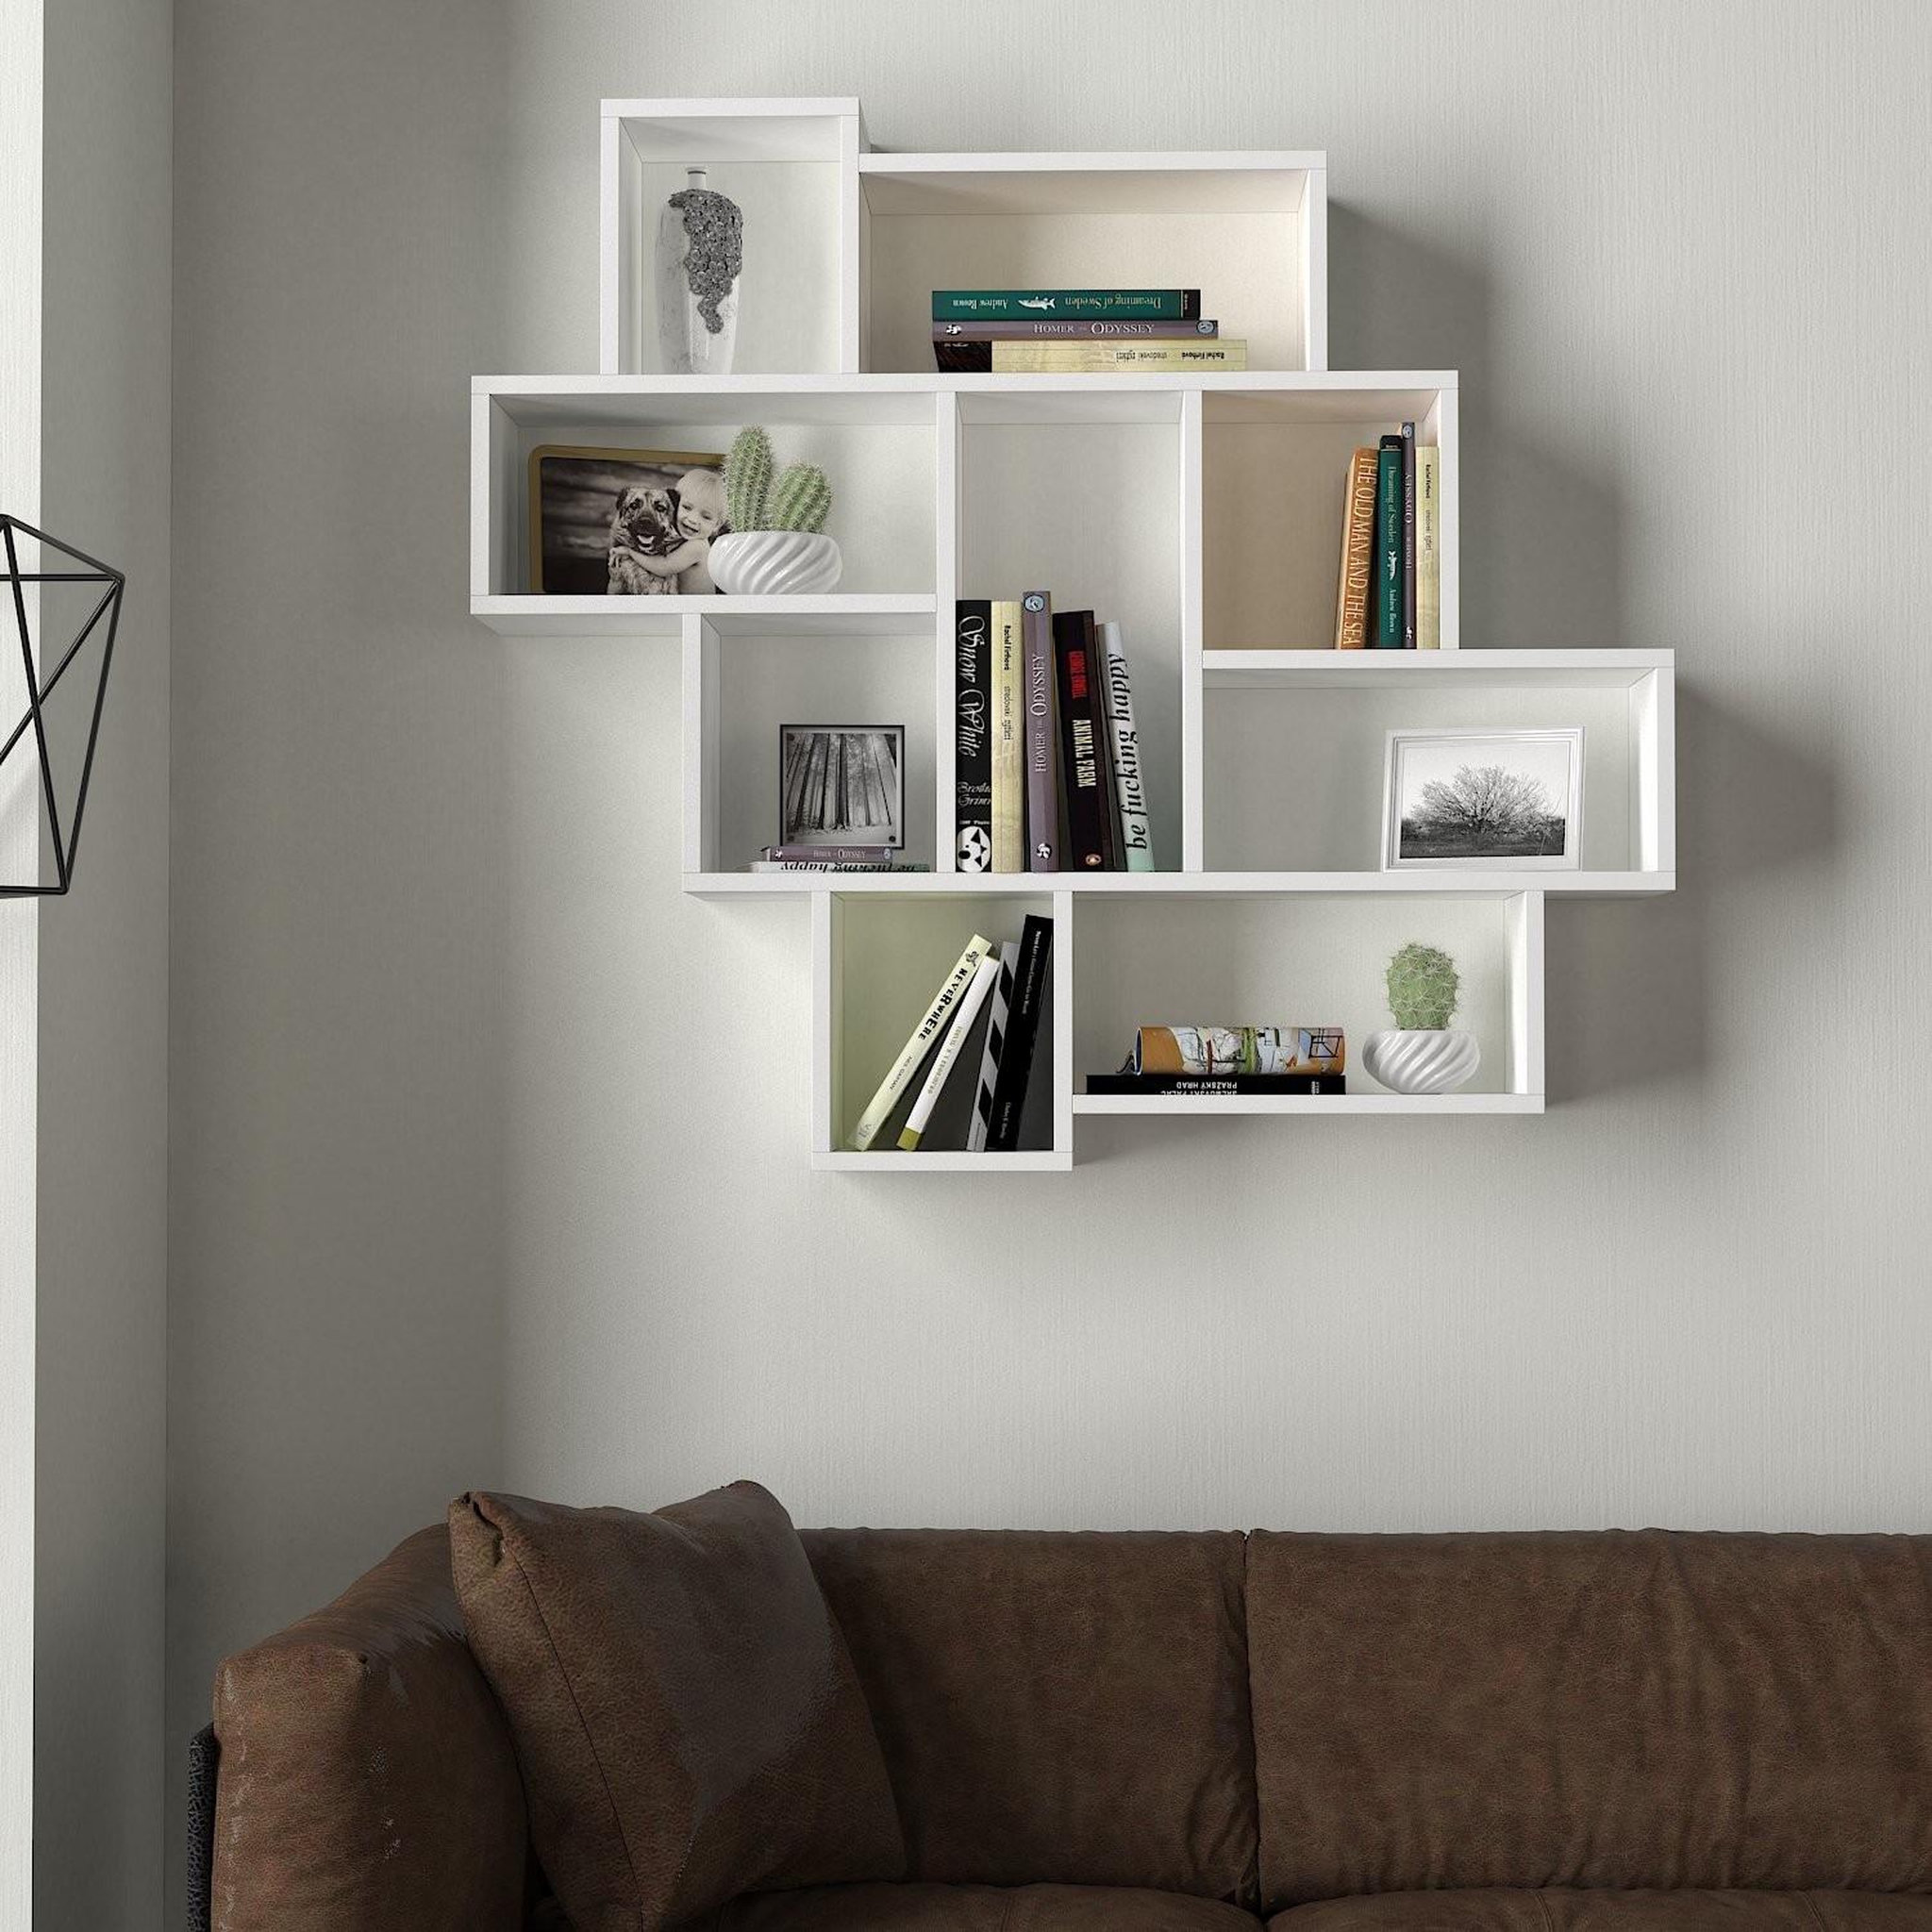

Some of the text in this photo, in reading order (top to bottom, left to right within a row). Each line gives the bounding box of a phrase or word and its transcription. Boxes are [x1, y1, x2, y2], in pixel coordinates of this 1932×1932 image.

[979, 298, 1008, 309] Andrew
[1065, 294, 1161, 309] Dreaming of Sweden
[1034, 324, 1074, 333] HOMER
[1091, 322, 1155, 334] ODYSSEY
[1386, 466, 1397, 543] Dreaming of Sweden
[1404, 473, 1413, 524] ODYSSEY
[1342, 457, 1378, 646] THE OLD MAN AND THE SEA
[1389, 587, 1397, 611] Andrew
[958, 615, 985, 758] Snow White
[1030, 654, 1046, 717] ODYSSEY
[1035, 733, 1047, 773] HOMER
[1073, 719, 1097, 788] ANIMAL FARM
[1108, 654, 1148, 851] be fucking happy
[918, 968, 967, 1040] NEVERWHERE
[1201, 1082, 1237, 1091] PRAŽSKÝ
